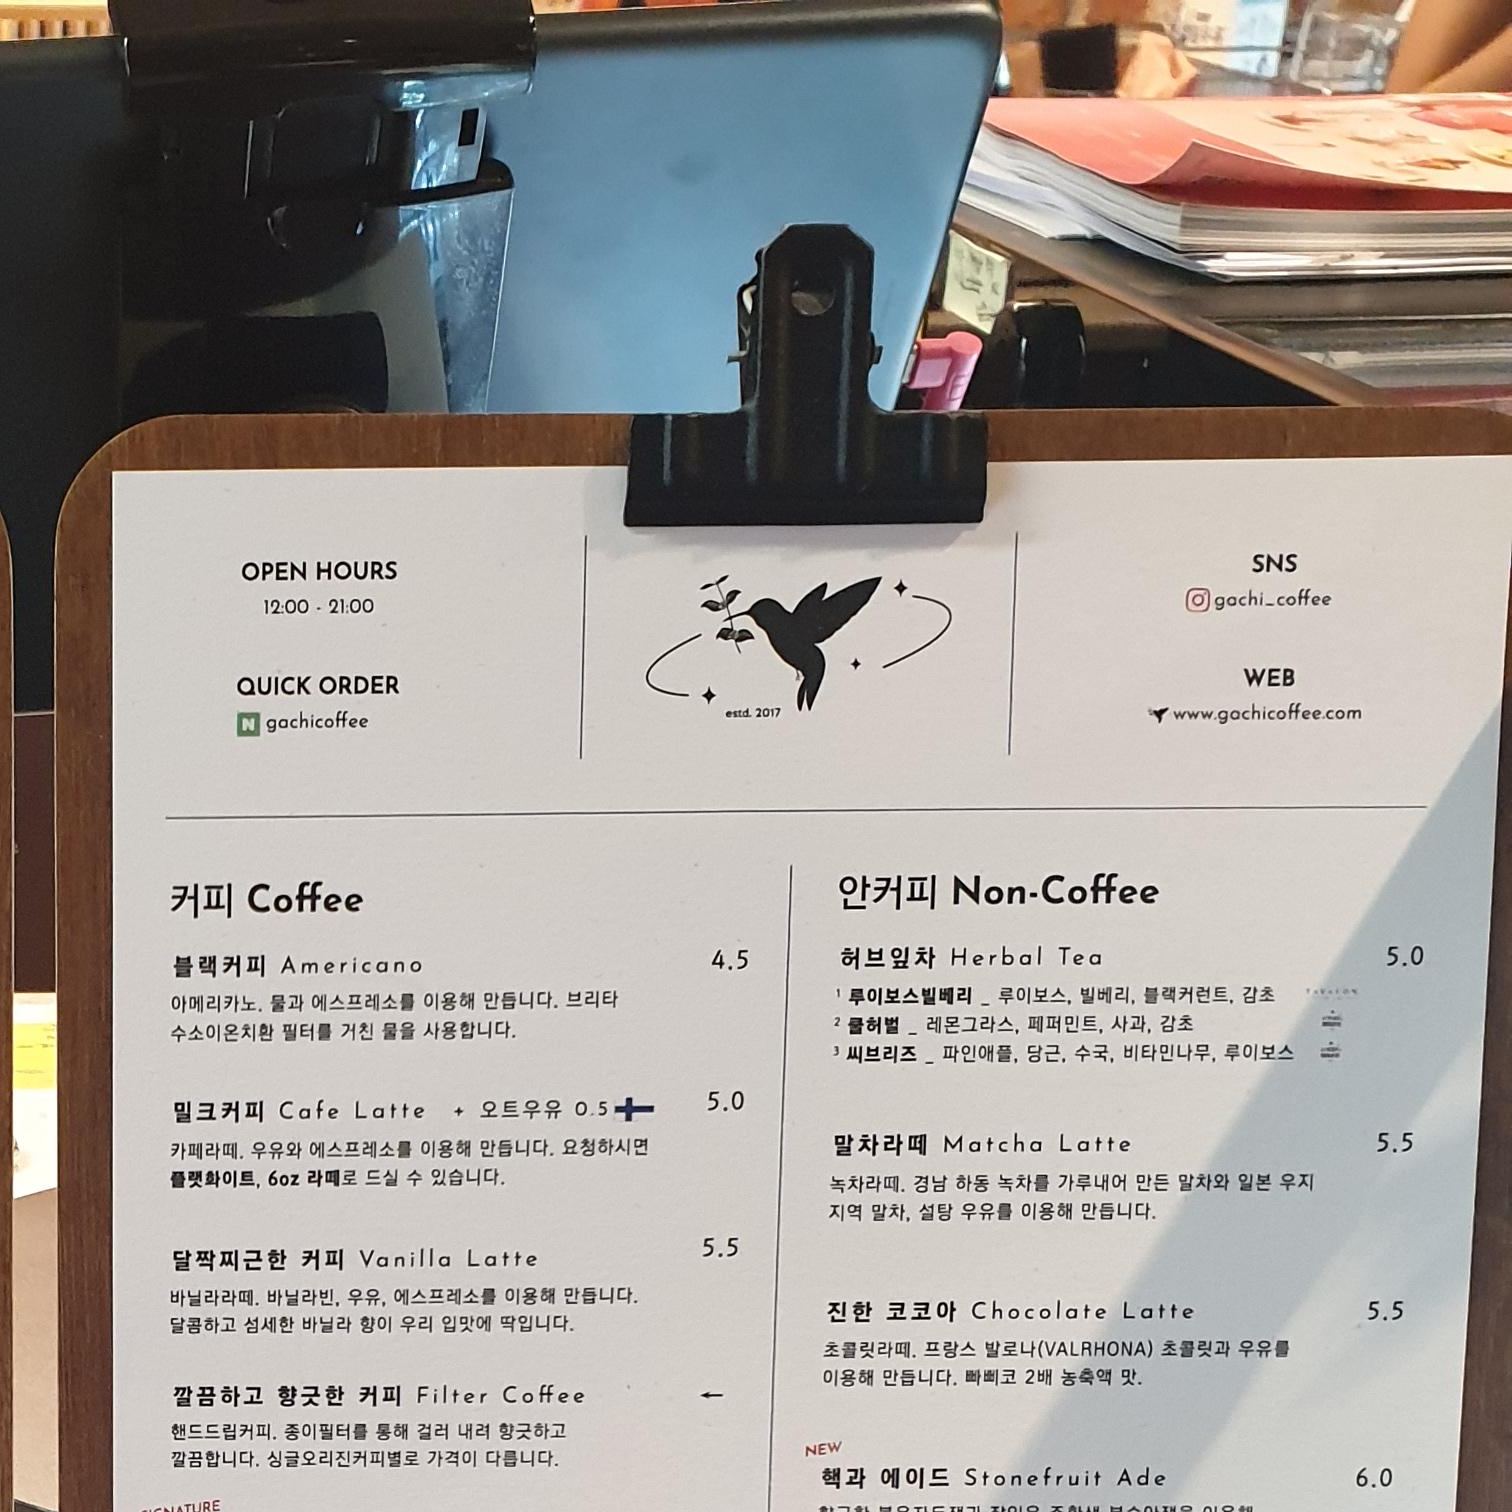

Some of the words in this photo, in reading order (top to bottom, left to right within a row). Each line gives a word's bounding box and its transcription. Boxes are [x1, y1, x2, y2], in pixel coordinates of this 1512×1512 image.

[242, 561, 306, 581] OPEN
[317, 561, 397, 580] HOURS
[1252, 554, 1297, 573] SNS
[264, 599, 309, 614] 12:00
[329, 599, 374, 614] 21:00
[1215, 588, 1332, 610] gachi_coffee
[237, 676, 311, 696] QUICK
[319, 675, 399, 695] ORDER
[1244, 668, 1295, 687] WEB
[266, 711, 368, 733] gachicoffee
[726, 708, 752, 718] estd.
[755, 708, 781, 718] 2017
[1173, 703, 1361, 724] www.gachicoffee.com
[171, 883, 232, 919] 커피
[248, 881, 363, 913] Coffee
[839, 875, 936, 910] 안커피
[953, 873, 1159, 905] Non-Coffee
[174, 955, 265, 978] 블랙커피
[281, 955, 421, 974] Americano
[712, 949, 748, 970] 4.5
[841, 947, 936, 970] 허브잎차
[952, 946, 1041, 966] Herbal
[1058, 947, 1101, 965] Tea
[1387, 946, 1423, 966] 5.0
[174, 1100, 263, 1123] 밀크커피
[280, 1099, 338, 1119] Cafe
[356, 1101, 424, 1119] Latte
[708, 1091, 744, 1111] 5.0
[835, 1134, 927, 1157] 말차라떼
[944, 1133, 1042, 1152] Matcha
[1060, 1134, 1130, 1152] Latte
[1377, 1132, 1413, 1153] 5.5
[703, 1237, 738, 1257] 5.5
[173, 1249, 287, 1272] 달짝찌근한
[302, 1249, 343, 1271] 커피
[360, 1248, 450, 1268] Vanilla
[468, 1249, 537, 1267] Latte
[827, 1301, 872, 1323] 진한
[886, 1301, 956, 1323] 코코아
[972, 1300, 1106, 1319] Chocolate
[1124, 1302, 1194, 1319] Latte
[1368, 1301, 1403, 1321] 5.5
[806, 1441, 842, 1457] NEW
[822, 1468, 866, 1489] 핵과
[881, 1467, 949, 1489] 에이드
[964, 1467, 1101, 1486] Stonefruit
[1117, 1467, 1165, 1486] Ade
[1356, 1467, 1392, 1488] 6.0
